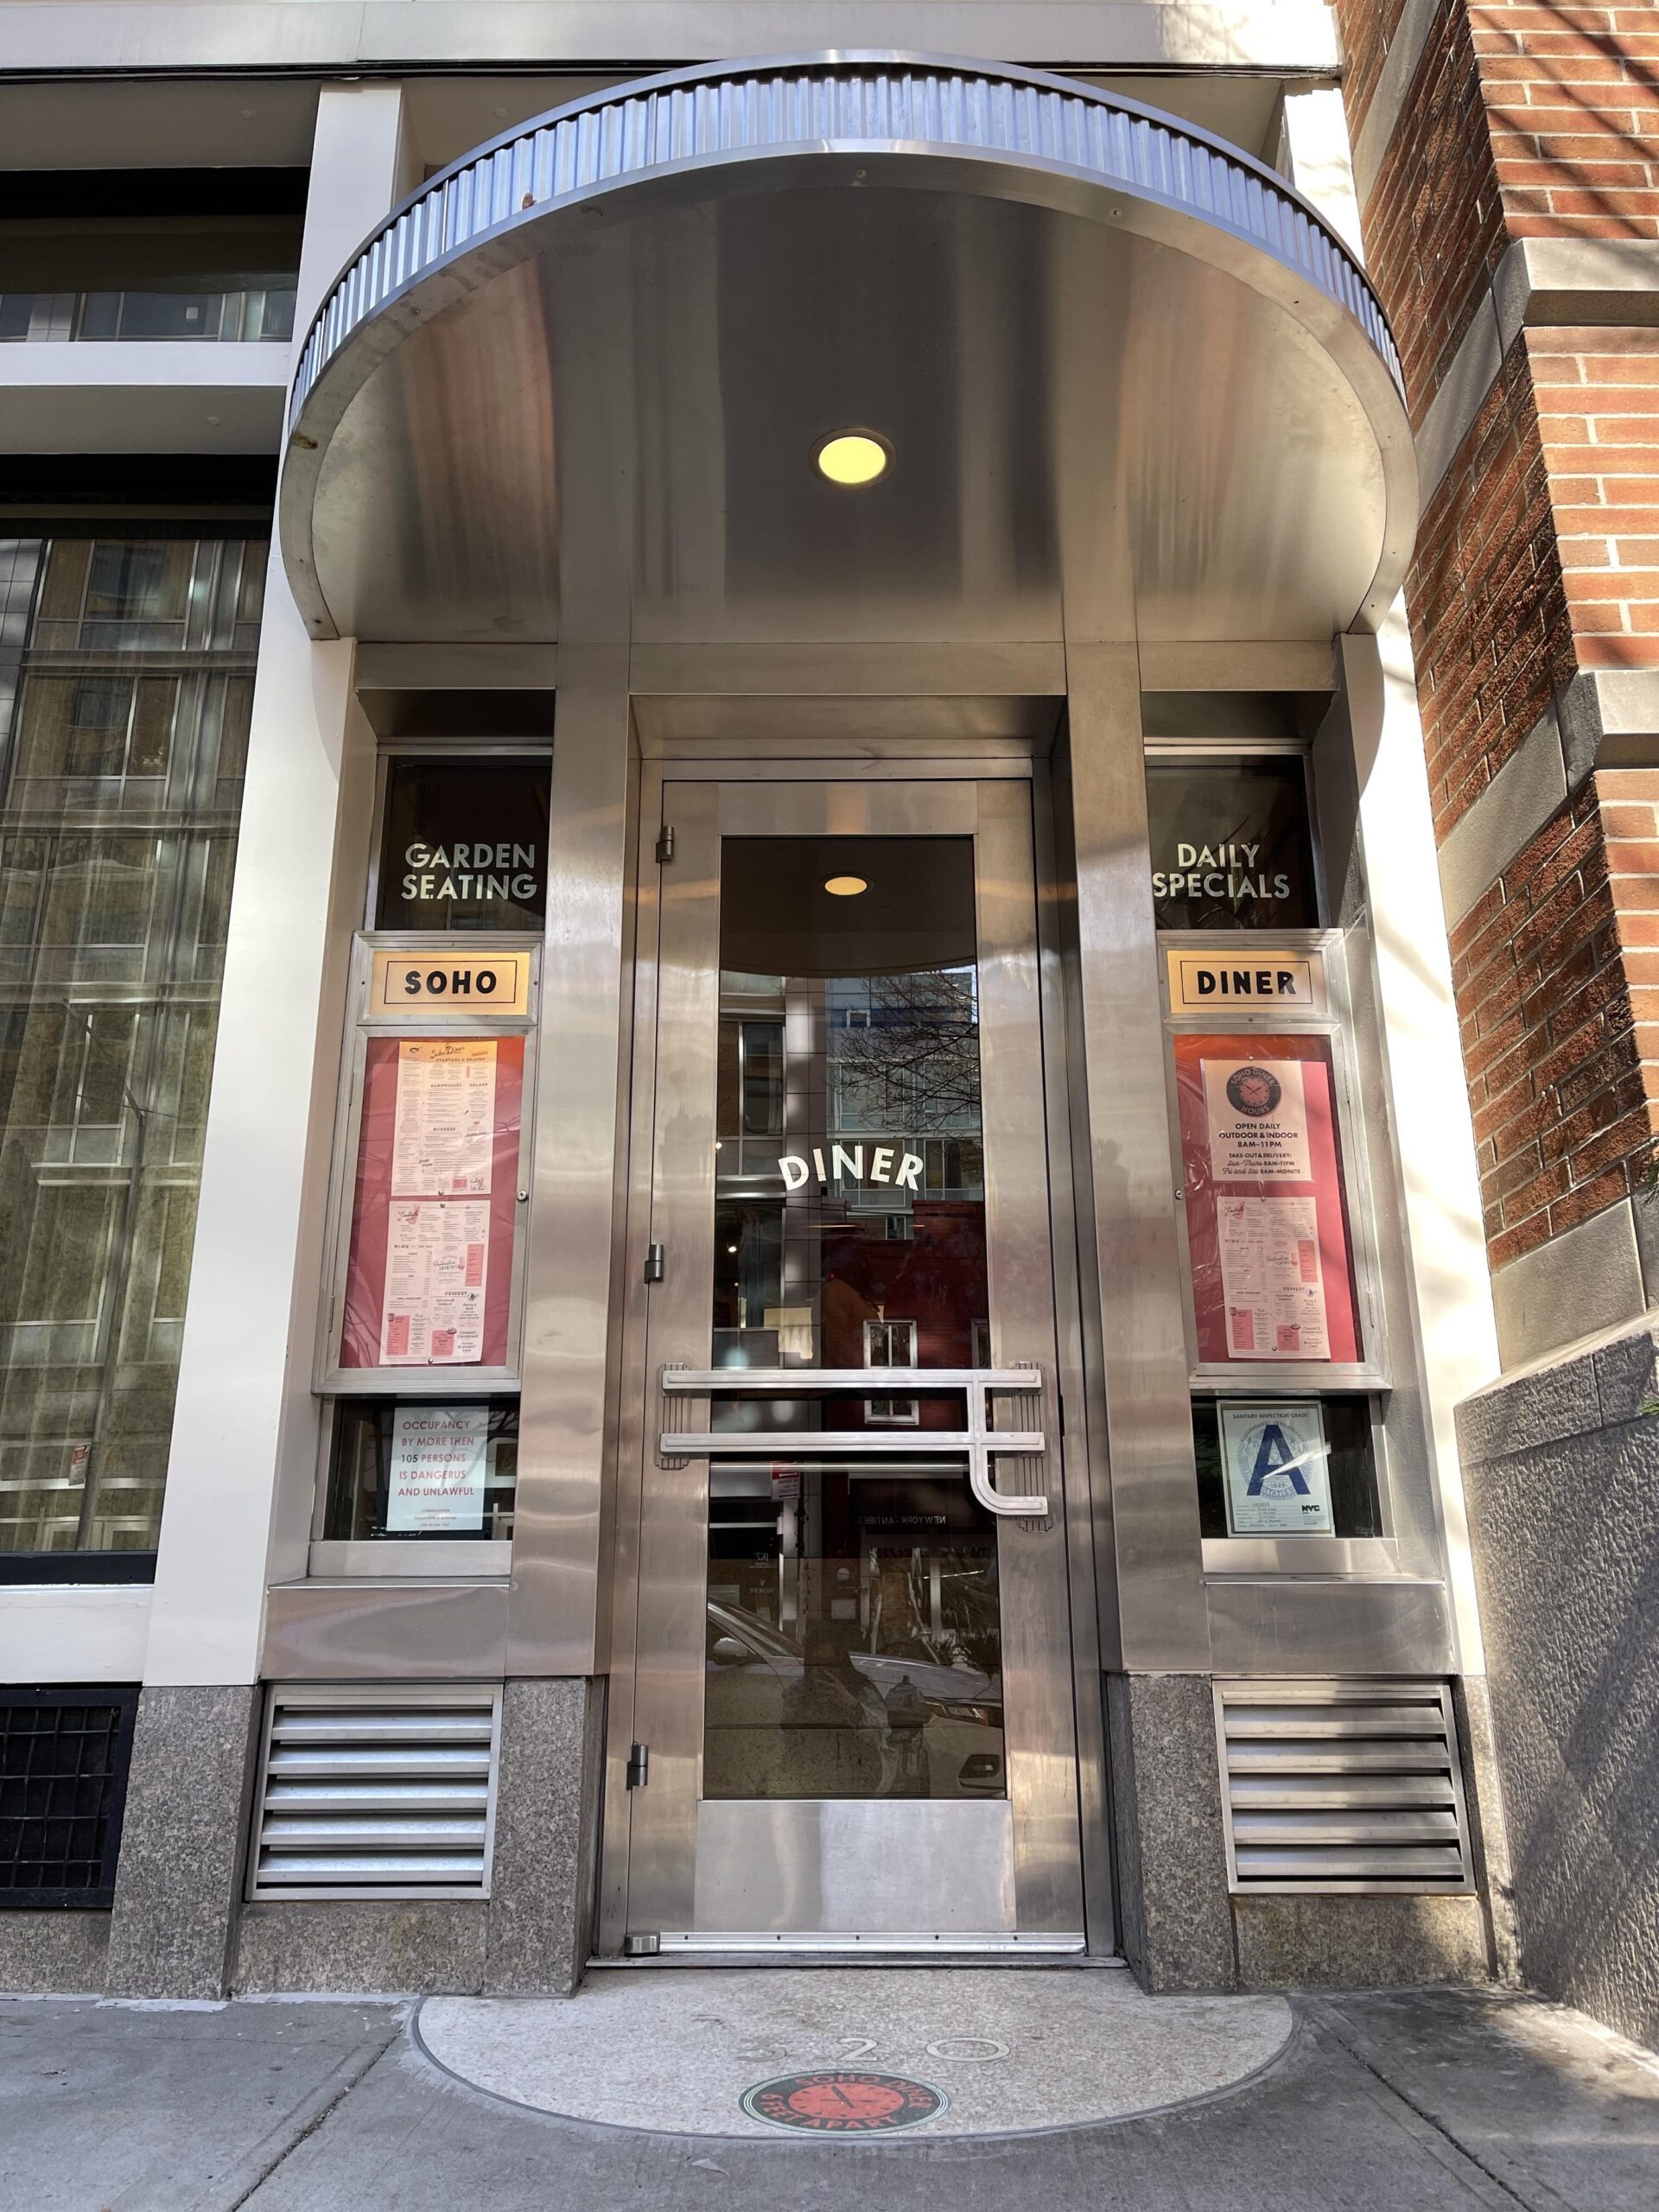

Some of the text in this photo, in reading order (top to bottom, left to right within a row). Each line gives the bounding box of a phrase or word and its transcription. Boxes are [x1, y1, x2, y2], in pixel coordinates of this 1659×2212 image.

[404, 843, 536, 868] GARDEN
[1177, 842, 1260, 868] DAILY
[401, 874, 537, 899] SEATING
[1152, 872, 1291, 899] SPECIALS
[404, 970, 497, 995] SOHO
[1197, 971, 1297, 995] DINER
[1230, 1068, 1275, 1087] SOHO DINER
[1241, 1105, 1271, 1115] HOURS
[778, 1145, 924, 1191] DINER
[403, 1421, 470, 1430] OCCUPANCY
[402, 1437, 474, 1446] BY MORE THEN
[401, 1453, 466, 1463] 105 PERSONS
[1246, 1425, 1311, 1496] A
[411, 1471, 466, 1479] DANGERUS
[398, 1487, 474, 1497] AND UNLAWFUL
[795, 2074, 933, 2109] SOHO DINER
[759, 2098, 803, 2122] FEET
[802, 2115, 900, 2130] APART
